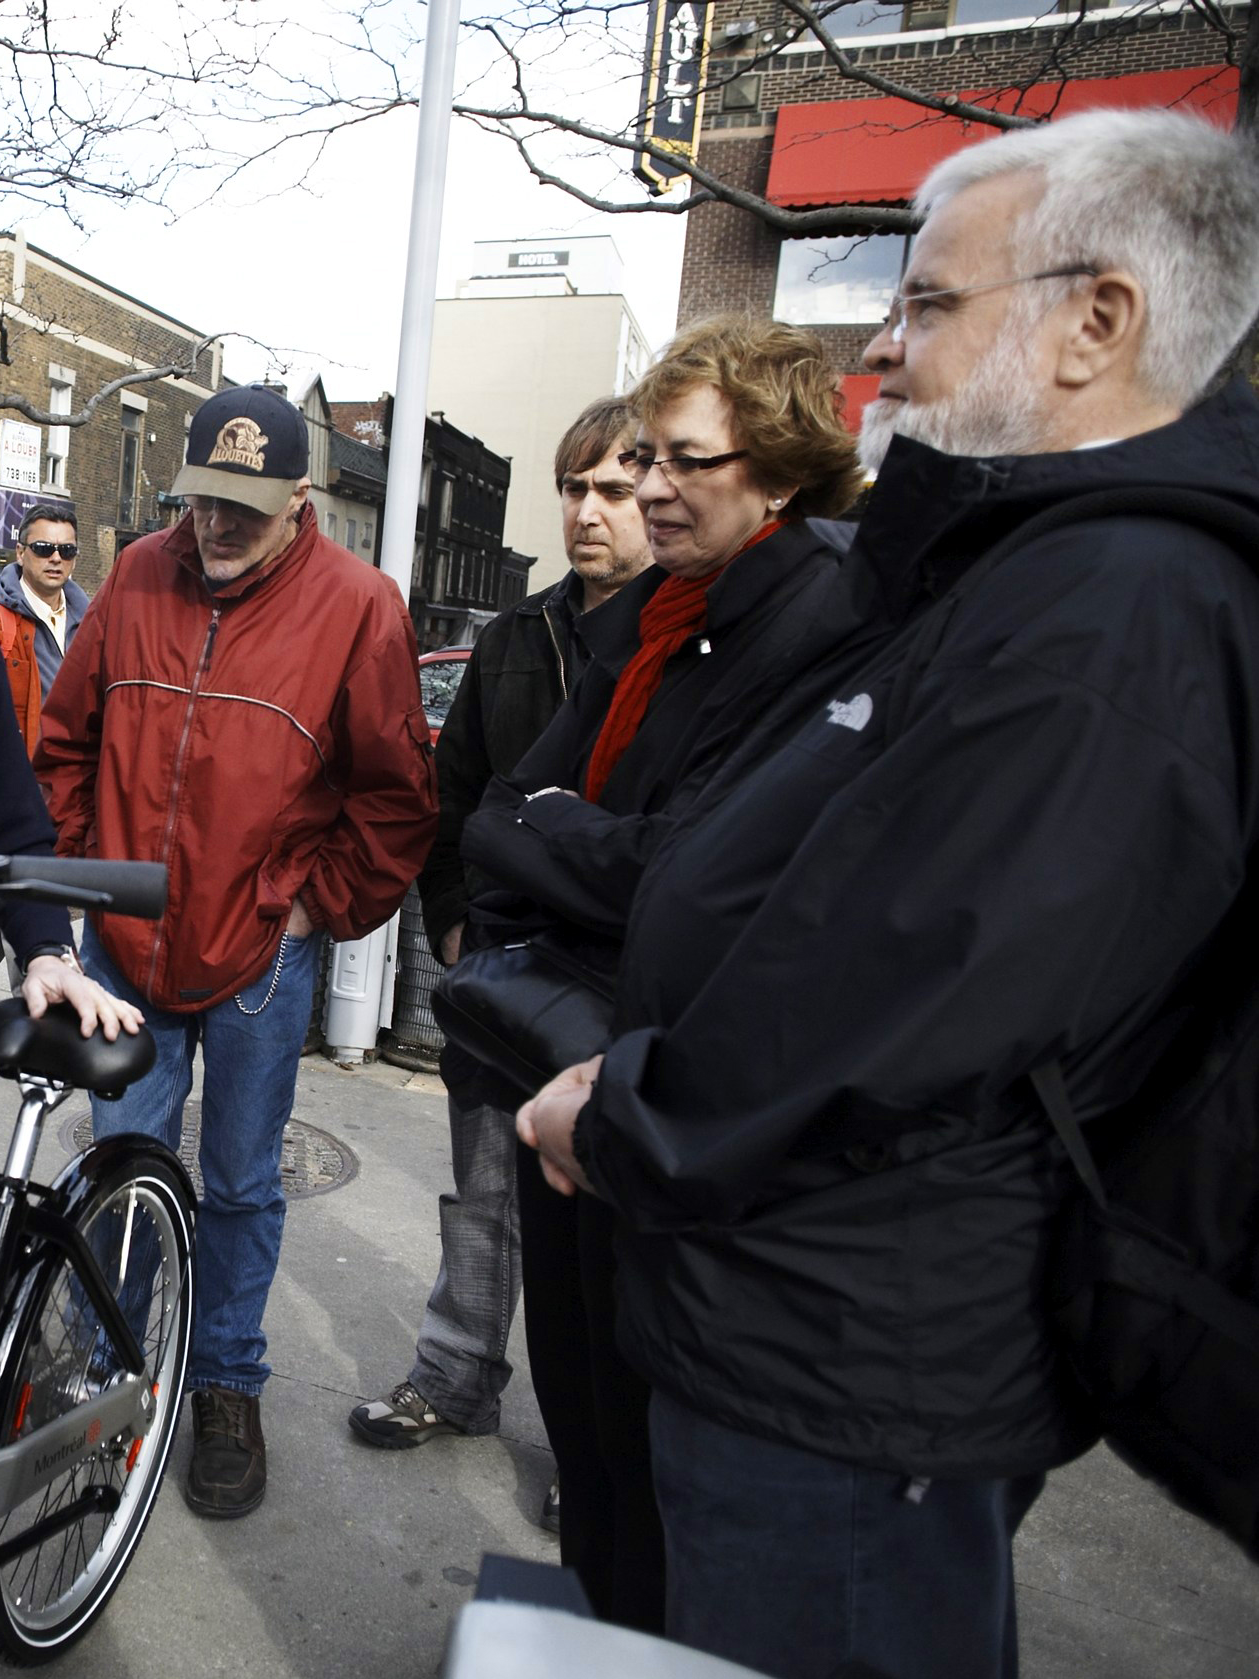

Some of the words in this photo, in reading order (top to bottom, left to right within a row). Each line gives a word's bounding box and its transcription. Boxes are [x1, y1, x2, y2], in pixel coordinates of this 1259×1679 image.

[518, 253, 558, 266] HOTEL
[11, 441, 37, 457] LOUER
[206, 447, 266, 472] ALOUETTES
[34, 1430, 87, 1477] Montréal
